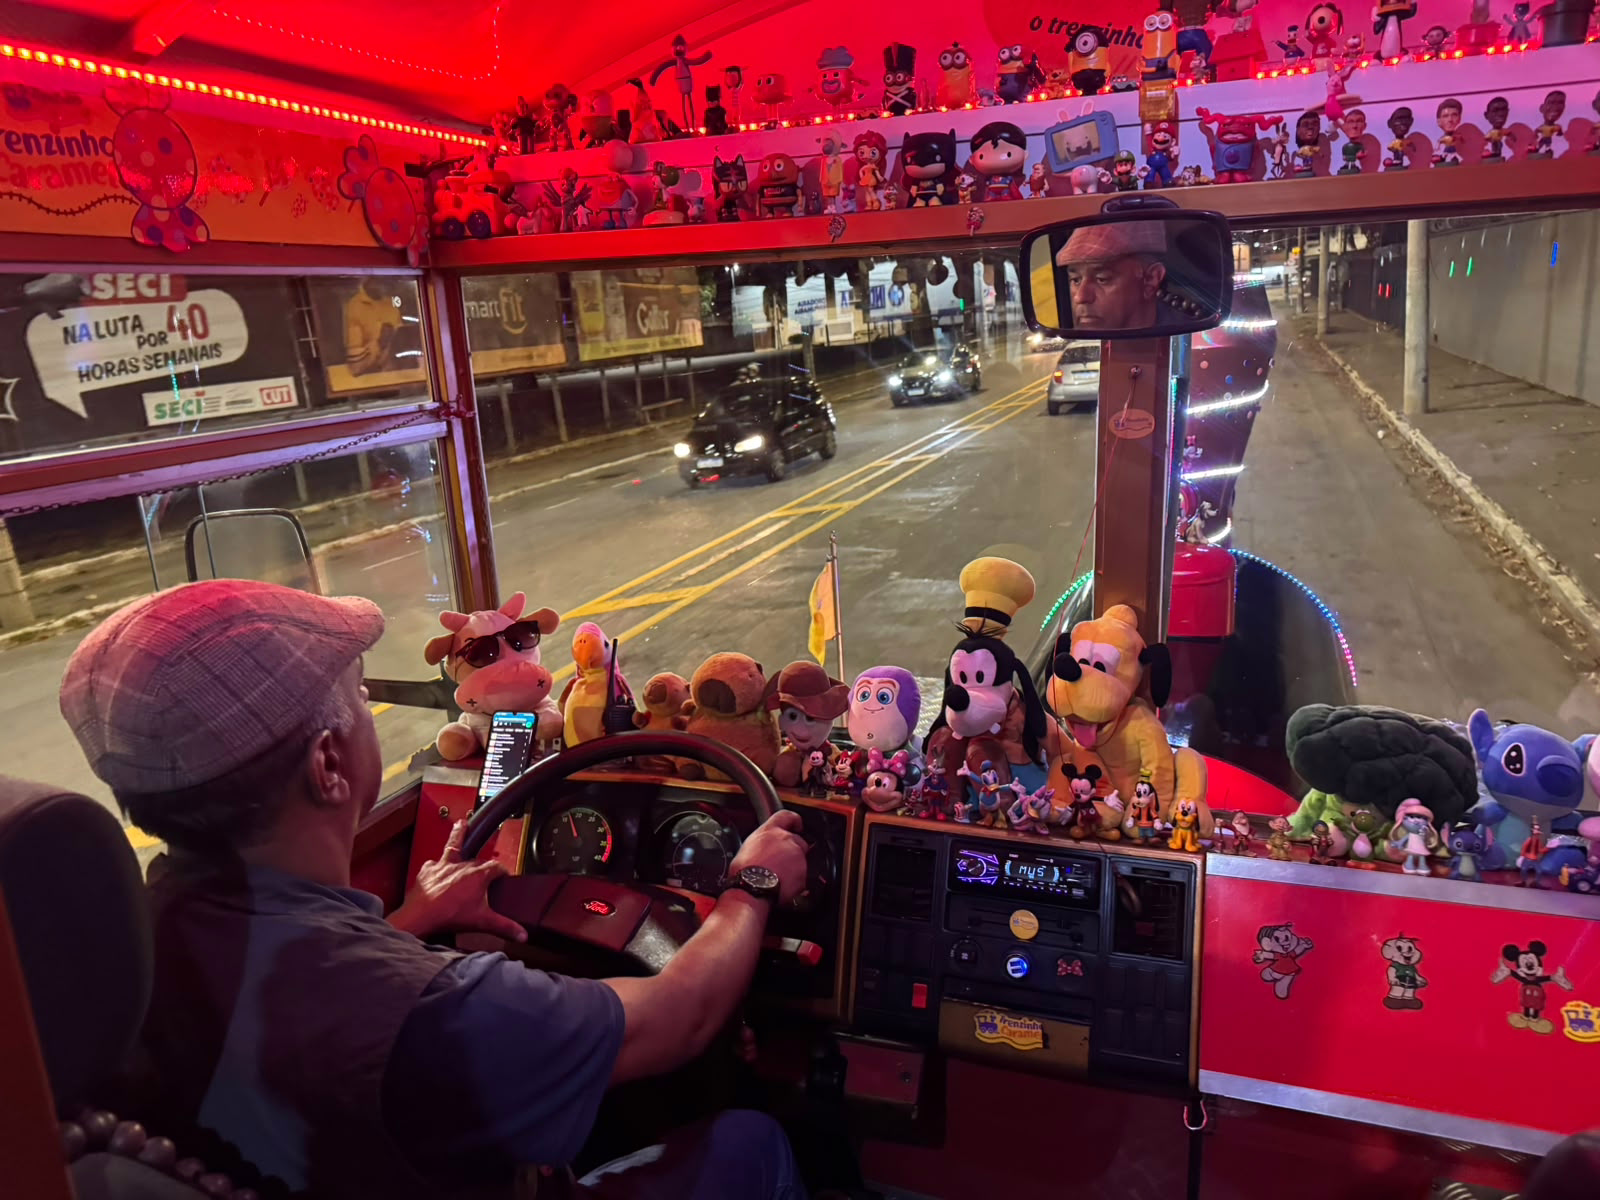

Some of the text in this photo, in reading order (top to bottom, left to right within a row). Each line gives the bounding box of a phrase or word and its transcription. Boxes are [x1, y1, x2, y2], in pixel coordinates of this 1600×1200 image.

[1030, 16, 1144, 49] o treinho
[0, 128, 114, 158] enzinho
[92, 273, 172, 300] SECI
[464, 300, 500, 319] mart
[63, 315, 144, 345] NA LUTA
[136, 303, 210, 350] POR 40
[78, 342, 222, 383] HORAS SEMANAIS
[153, 399, 203, 420] SECI
[262, 386, 291, 405] CUT
